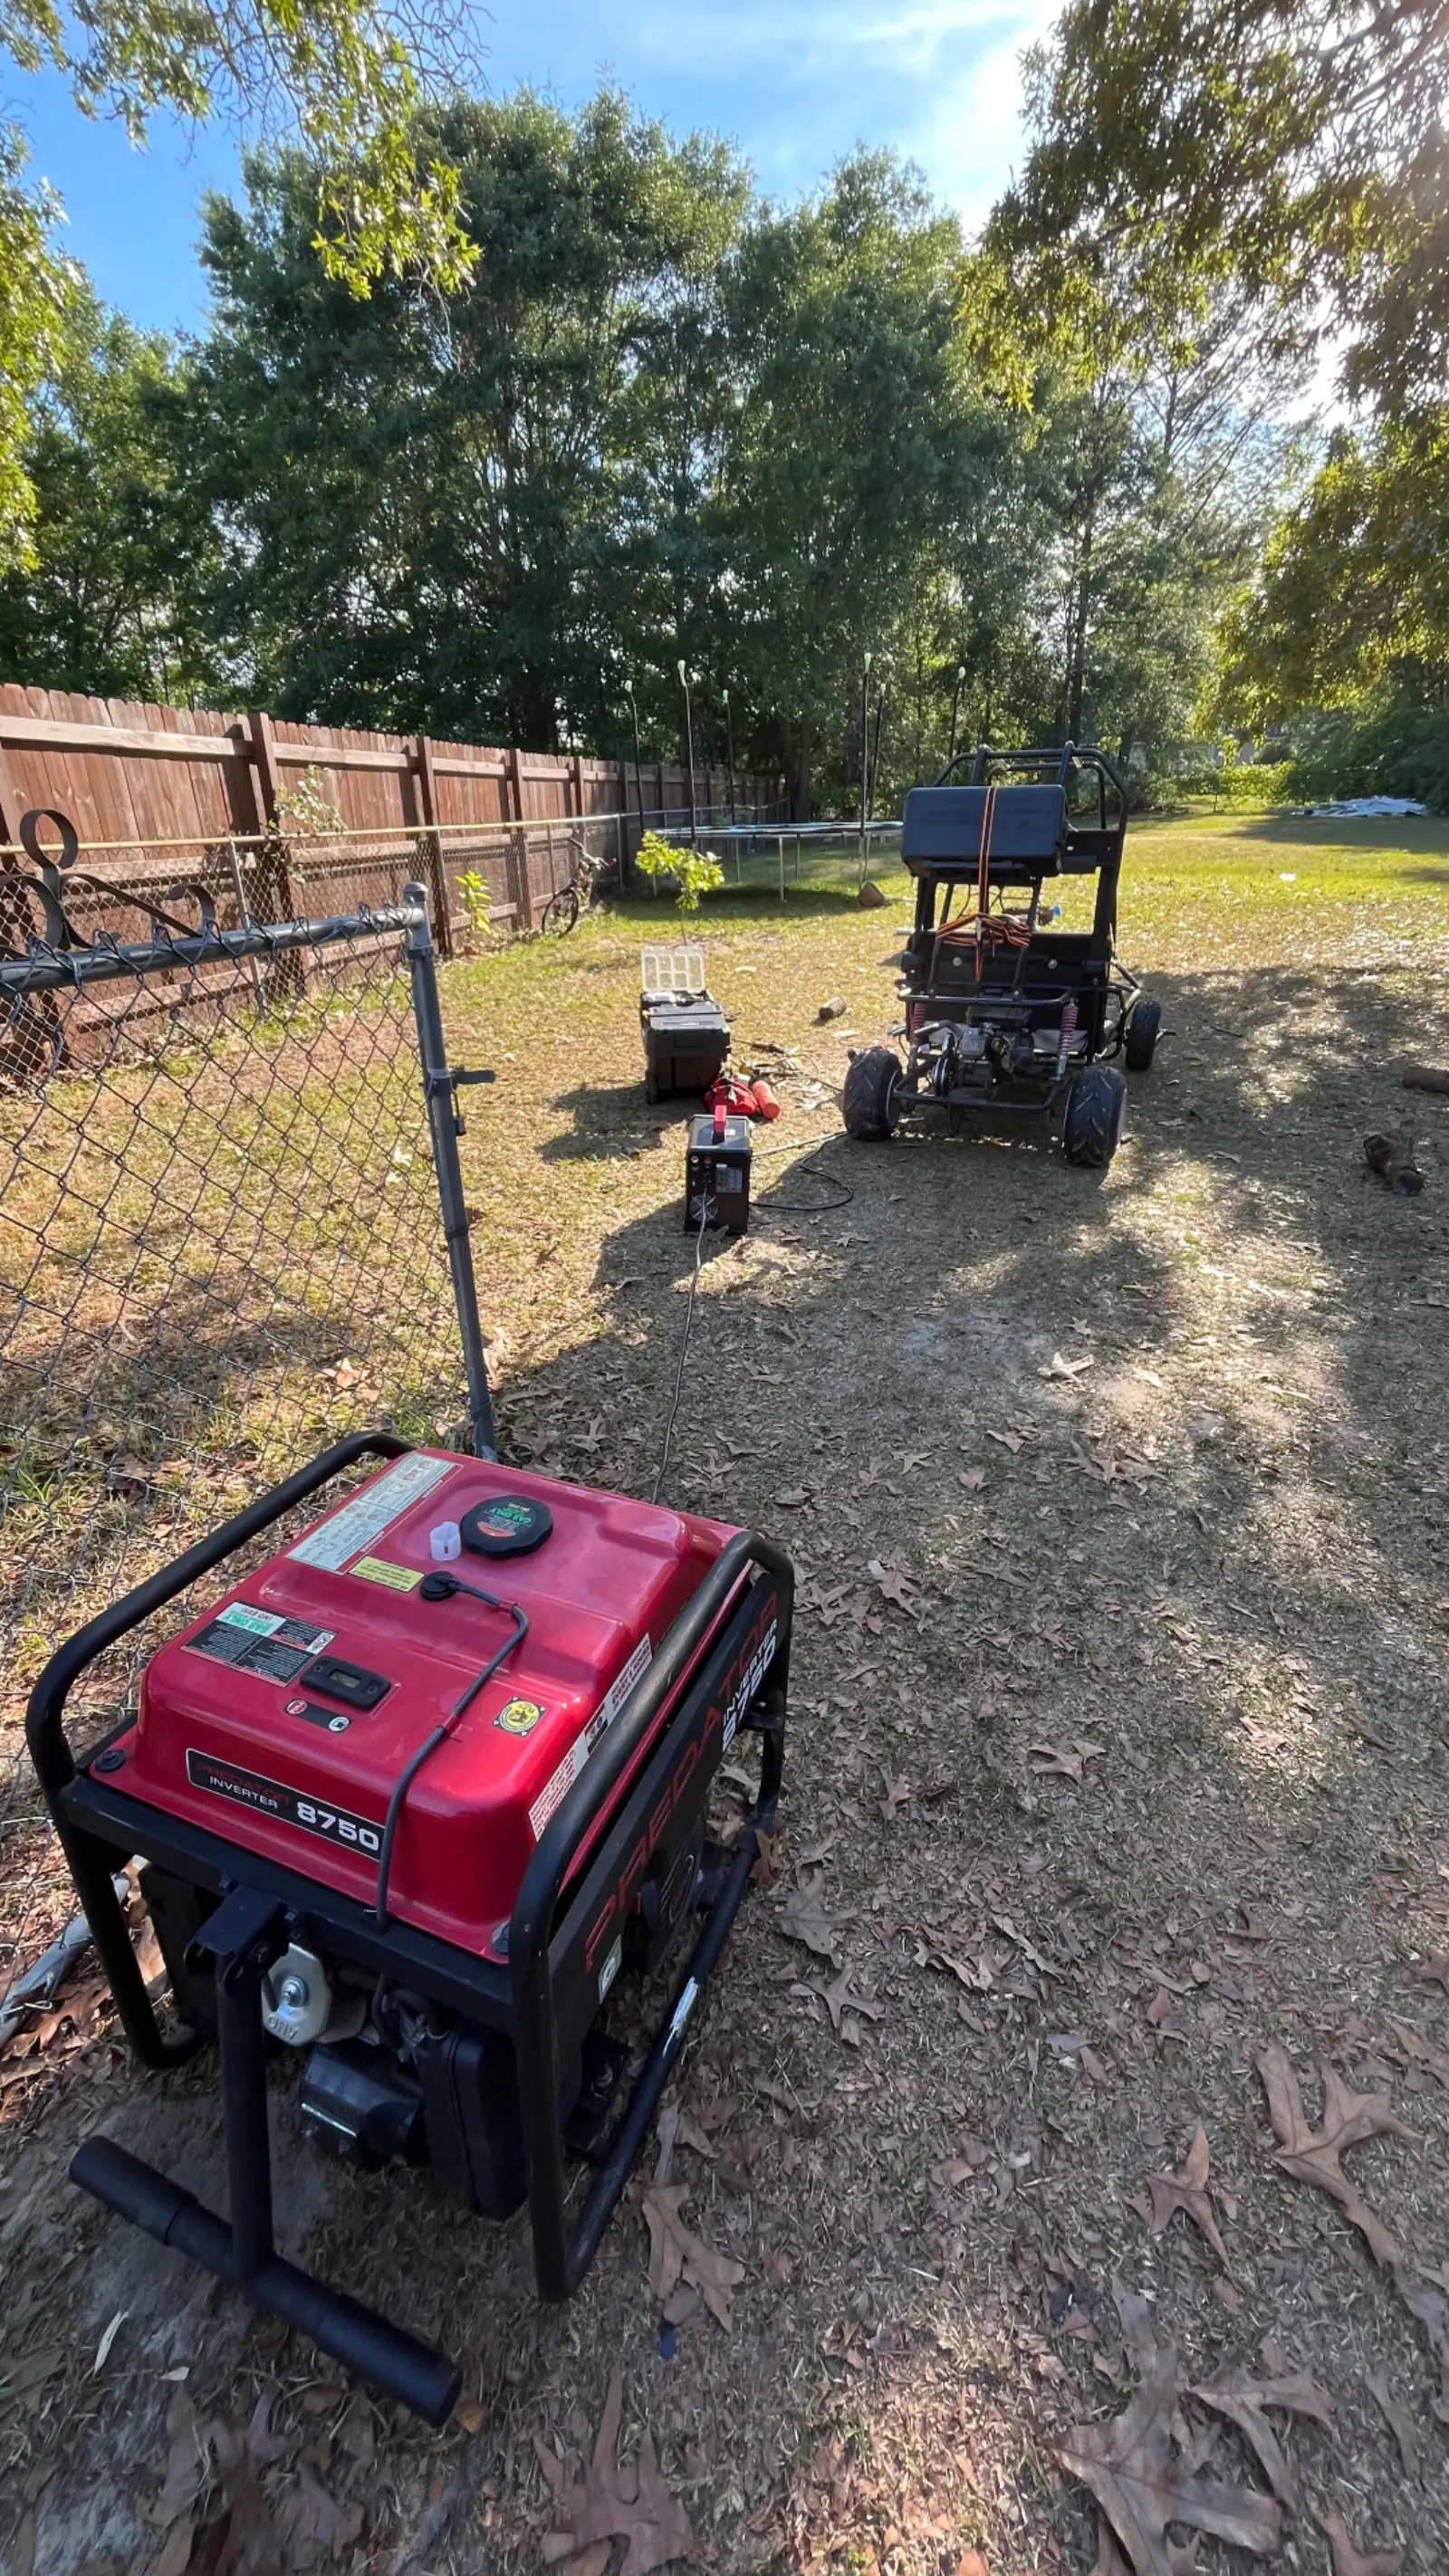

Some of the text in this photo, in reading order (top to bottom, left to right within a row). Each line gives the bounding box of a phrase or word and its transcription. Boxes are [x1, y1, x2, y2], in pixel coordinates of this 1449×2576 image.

[722, 1634, 777, 1753] 8750
[209, 1776, 279, 1810] INVERTER
[296, 1801, 380, 1852] 8750
[267, 2014, 300, 2040] OHV
